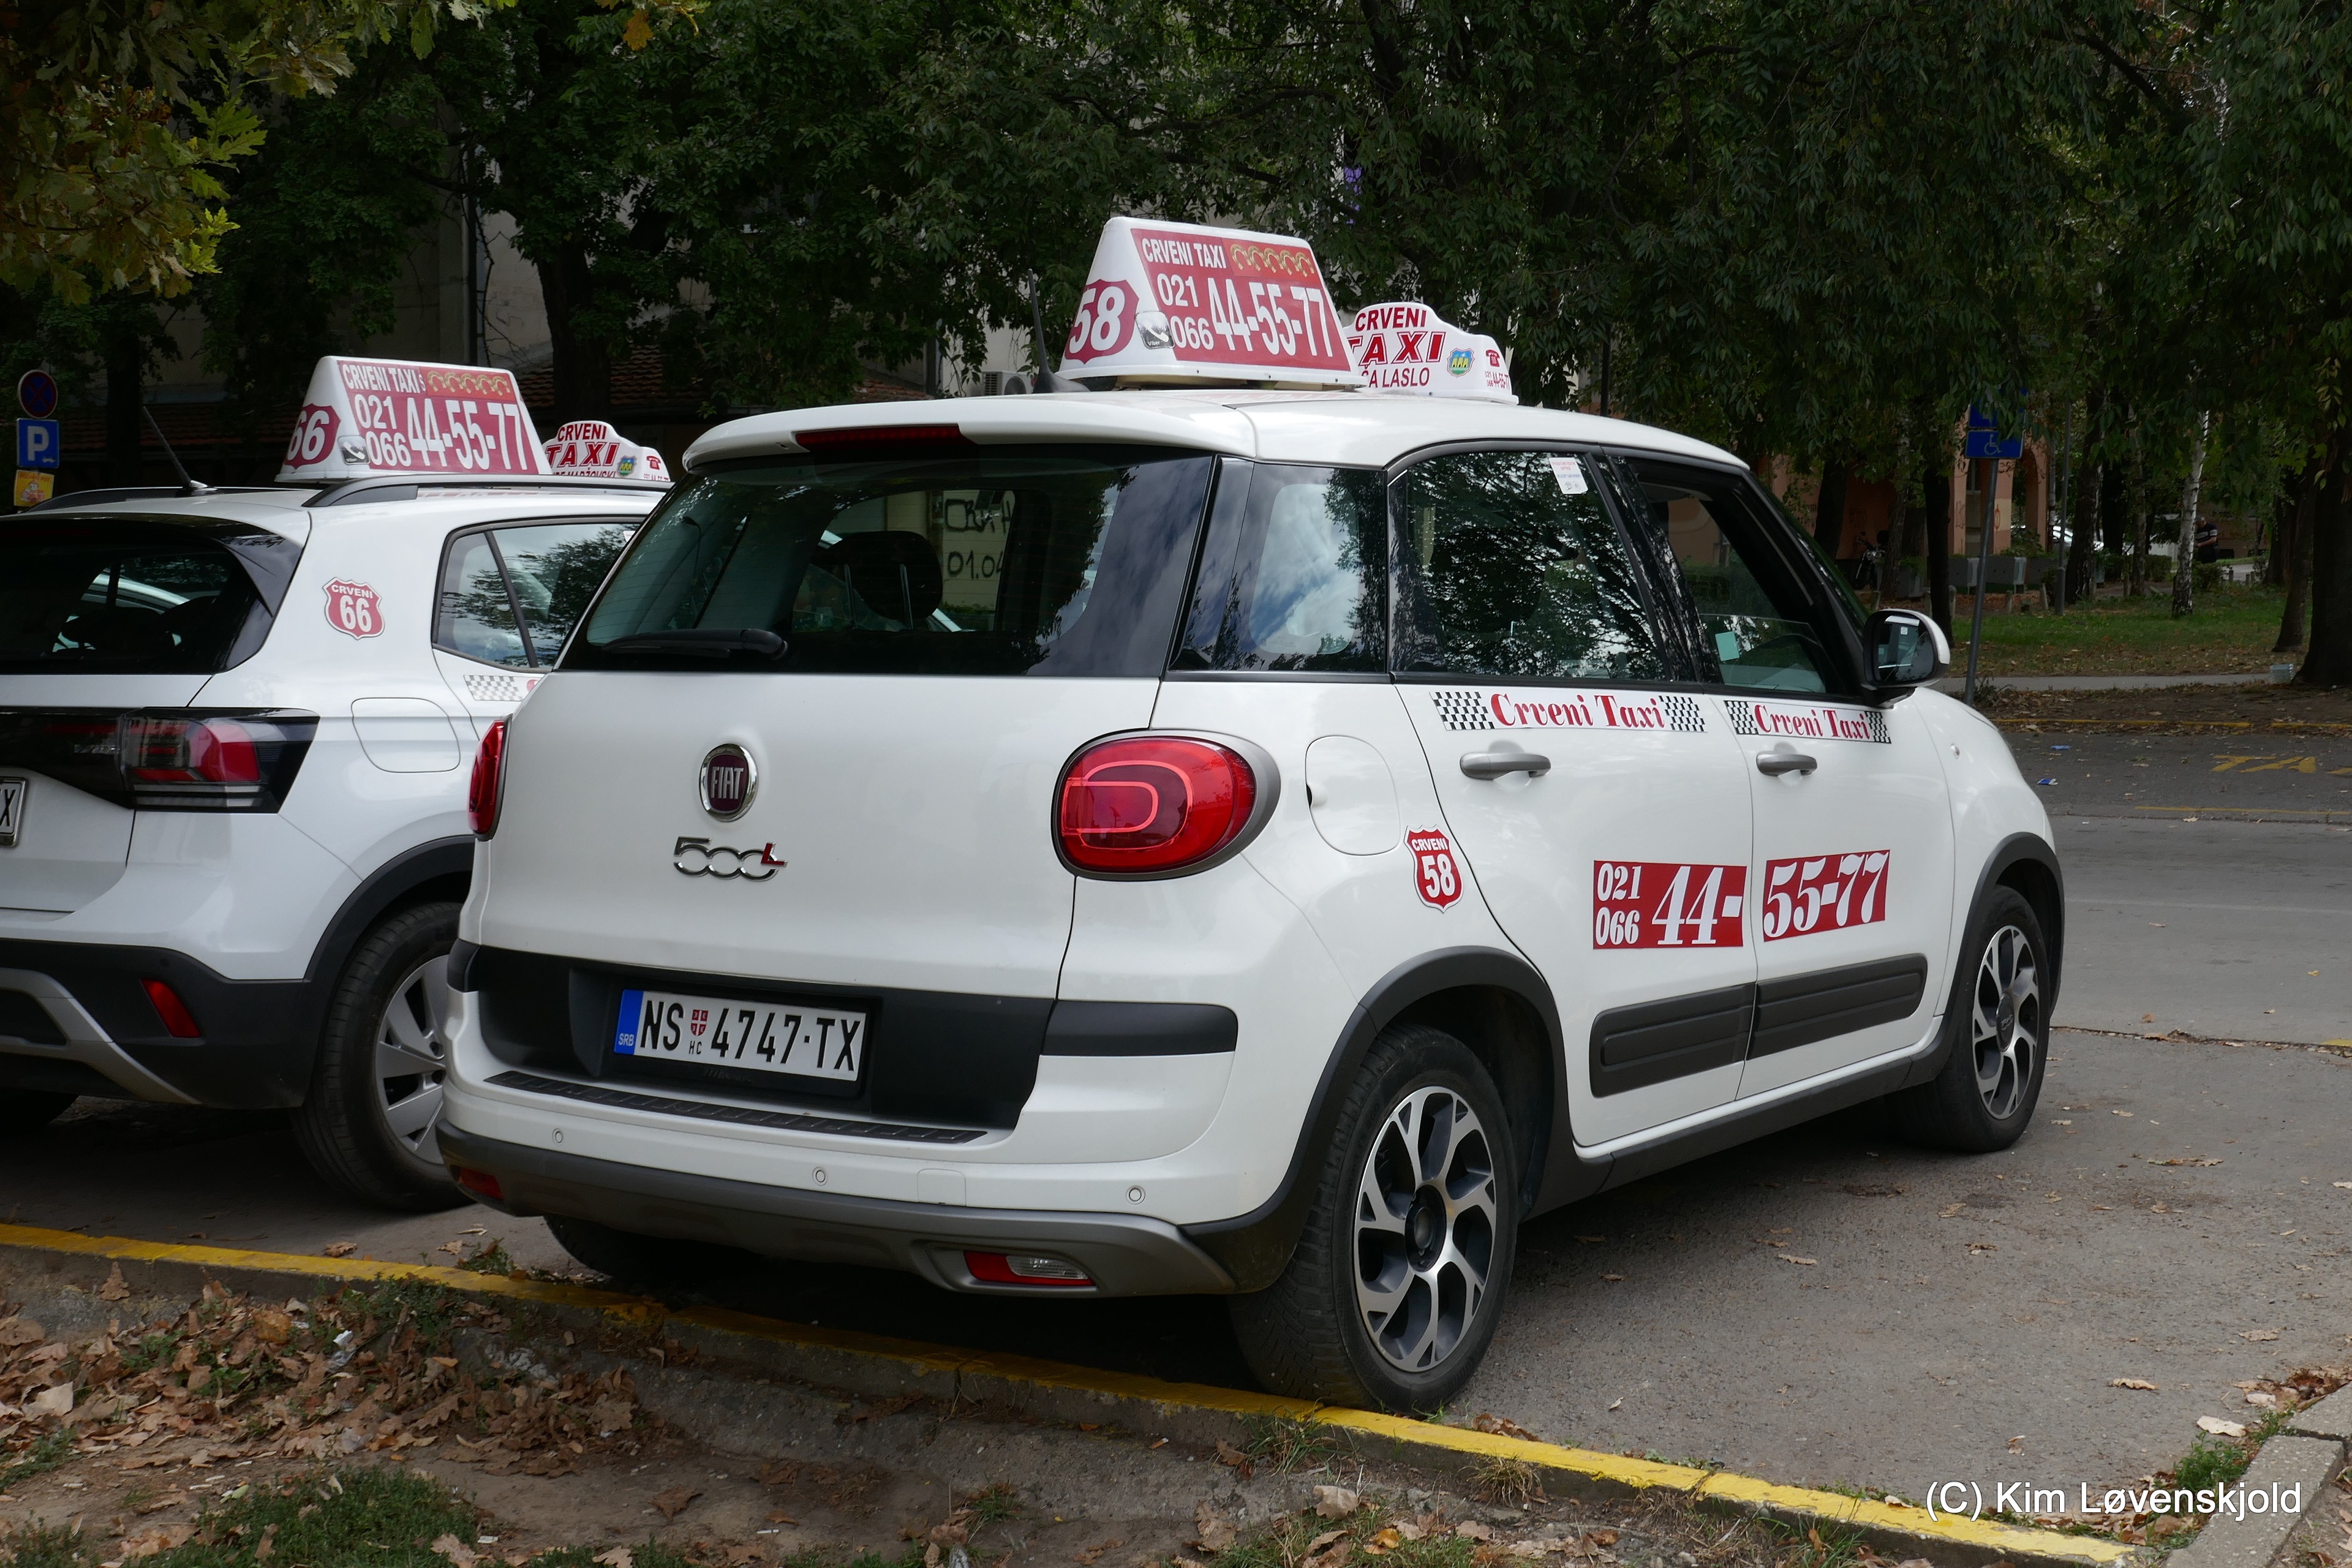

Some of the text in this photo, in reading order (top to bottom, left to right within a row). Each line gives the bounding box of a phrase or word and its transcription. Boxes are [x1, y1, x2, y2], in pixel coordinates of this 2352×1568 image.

[1142, 238, 1227, 269] CRVENI TAXI
[1157, 273, 1199, 307] 021
[1069, 285, 1126, 353] 58
[1170, 315, 1213, 350] 066
[1207, 277, 1333, 358] 44-55-77
[1355, 307, 1427, 331] CRVENI
[342, 364, 391, 391] CRVENI
[388, 368, 421, 393] TAXI
[1382, 368, 1430, 388] LASLO
[354, 394, 397, 429] 021
[28, 426, 49, 461] P
[287, 410, 330, 461] 66
[367, 431, 412, 467] 066
[407, 398, 527, 470] 44-55-77
[558, 423, 607, 442] CRVENI
[545, 442, 620, 468] TAXI
[331, 585, 373, 598] CRVENI
[340, 595, 372, 632] 66
[1490, 693, 1665, 728] Crveni Taxi
[1754, 704, 1870, 740] Crveni Taxi
[710, 766, 744, 800] FIAT
[674, 836, 788, 881] 500L
[1411, 838, 1449, 851] CRVENI
[1422, 853, 1455, 899] 58
[1597, 862, 1642, 902] 021
[1651, 865, 1742, 945] 44-
[1763, 852, 1888, 938] 55-77
[1596, 907, 1640, 945] 066
[617, 1033, 635, 1047] SRB
[640, 1000, 684, 1052] NS
